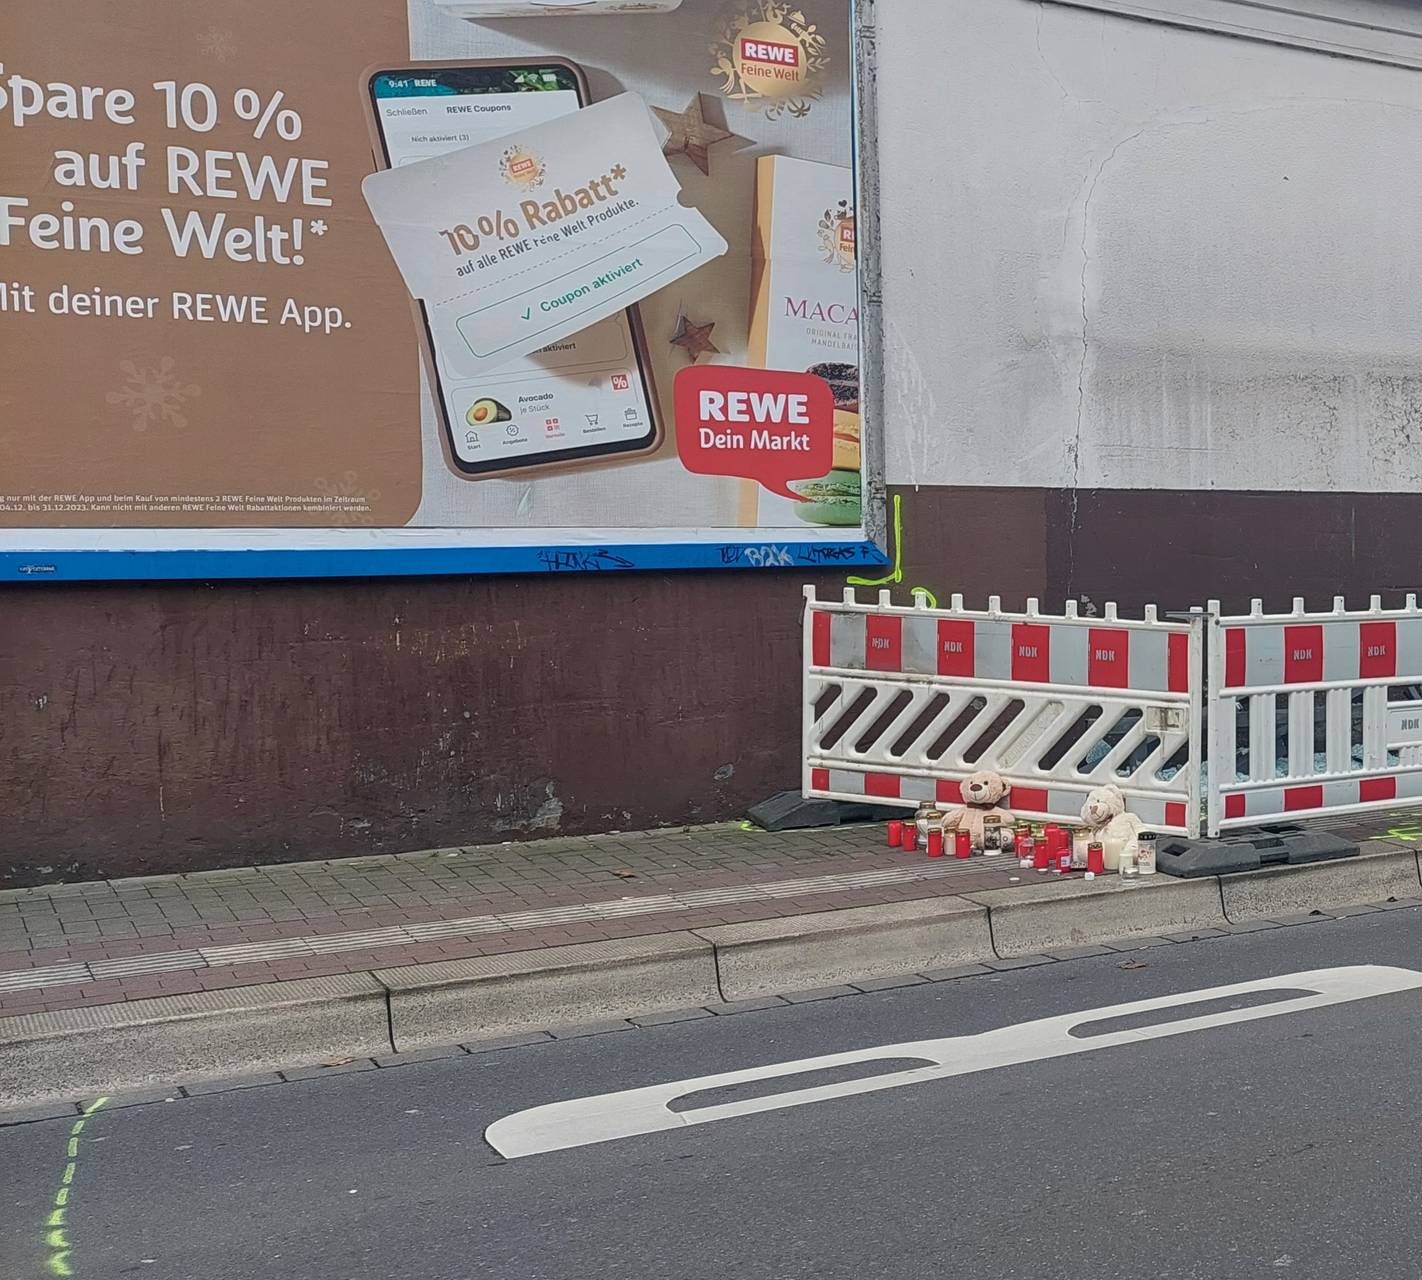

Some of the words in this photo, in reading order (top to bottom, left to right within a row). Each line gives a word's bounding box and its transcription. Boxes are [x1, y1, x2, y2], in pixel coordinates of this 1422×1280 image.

[744, 42, 795, 63] REWE
[741, 63, 772, 78] Feine
[773, 67, 800, 82] Welt
[388, 80, 409, 89] 9:41
[153, 81, 217, 132] 10
[233, 88, 303, 141] %
[386, 107, 428, 117] Schließen
[446, 105, 472, 114] REWE
[473, 104, 512, 114] Coupons
[54, 142, 146, 190] auf
[166, 146, 333, 206] REWE
[0, 196, 144, 255] Feine
[455, 260, 475, 277] auf
[476, 253, 498, 270] alle
[498, 240, 532, 262] REWE
[560, 220, 587, 239] Welt
[587, 199, 639, 228] Produkte.
[540, 284, 591, 312] Coupon
[592, 258, 644, 290] aktiviert
[48, 285, 159, 319] deiner
[172, 291, 269, 325] REWE
[280, 297, 352, 334] App.
[806, 327, 841, 340] ORIGINAL
[518, 393, 554, 403] Avocado
[528, 404, 551, 413] Stück
[699, 390, 810, 424] REWE
[699, 428, 744, 449] Dein
[750, 429, 811, 451] Markt
[79, 495, 96, 503] App
[246, 504, 301, 512] Rabattaktionen
[944, 641, 963, 652] NDK
[1019, 645, 1038, 657] NDK
[1367, 645, 1386, 657] NDK
[1294, 649, 1312, 660] NDK
[1401, 719, 1420, 730] NDK
